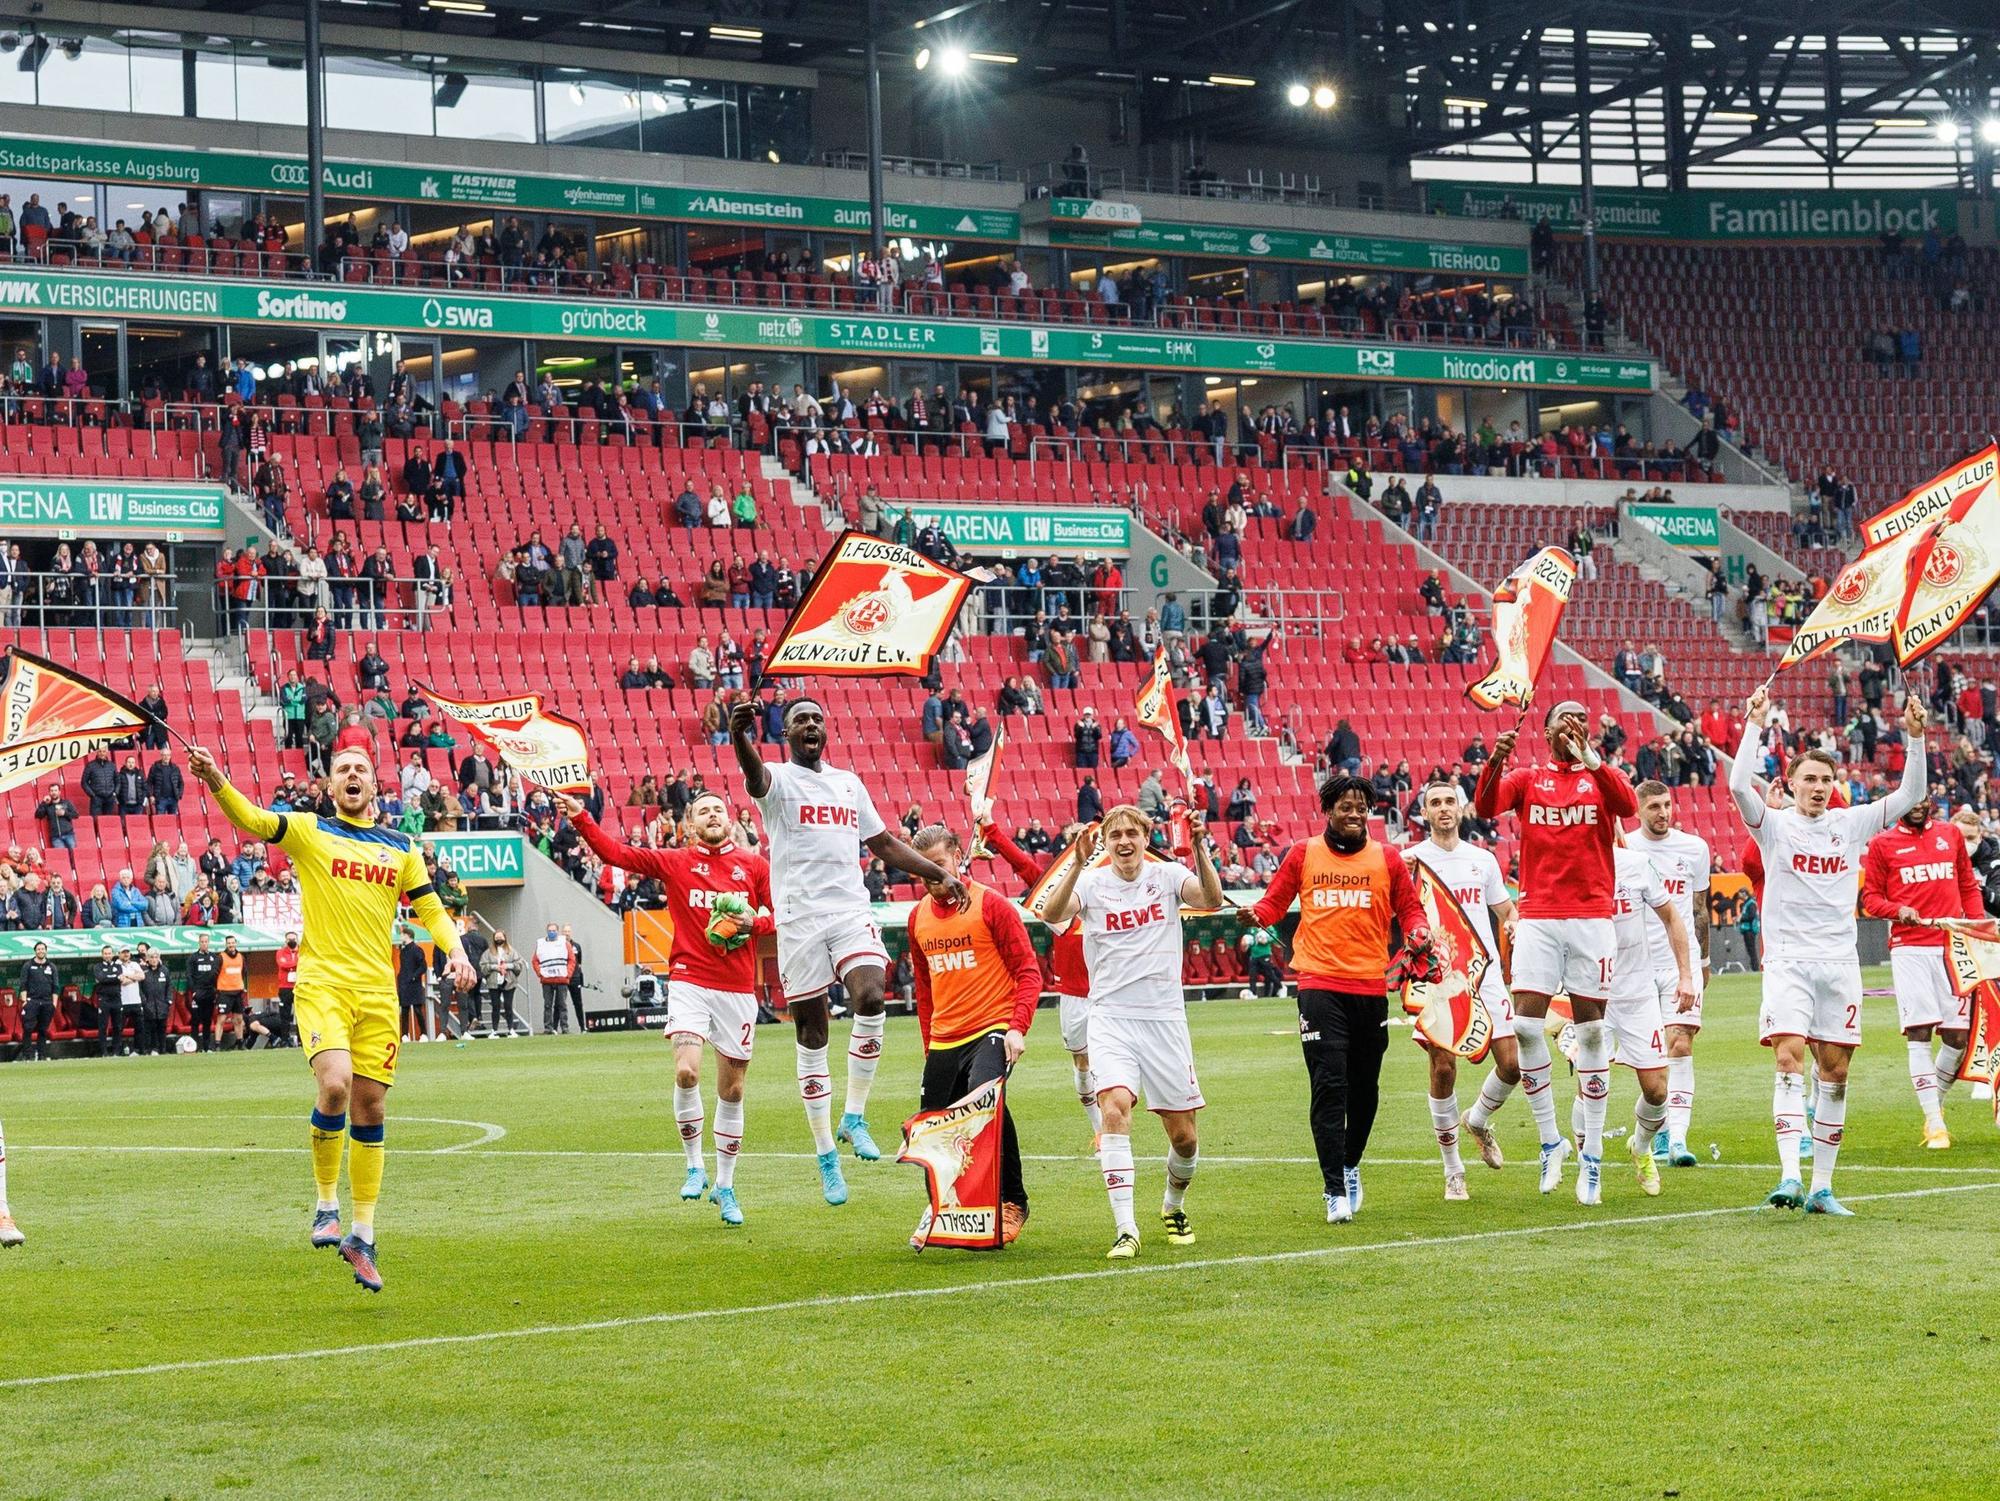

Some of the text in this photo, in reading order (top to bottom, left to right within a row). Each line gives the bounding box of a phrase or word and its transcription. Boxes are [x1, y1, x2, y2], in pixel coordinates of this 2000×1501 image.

[0, 151, 200, 183] Stadtsparkasse Augsburg
[323, 170, 374, 189] Audi
[451, 174, 517, 189] KASTNER
[705, 196, 803, 219] Abenstein
[834, 208, 908, 228] aumller
[1708, 199, 1939, 232] Familienblock
[1429, 252, 1501, 272] TIERHOLD
[47, 284, 217, 313] VERSICHERUNGEN
[257, 290, 347, 321] Sortimo
[445, 306, 494, 327] swa
[561, 308, 647, 333] grünbeck
[830, 323, 936, 343] STADLER
[1357, 349, 1395, 368] PCI
[1443, 356, 1511, 381] hitradio
[89, 492, 123, 520] LEW
[128, 499, 187, 516] Business
[189, 502, 219, 518] Club
[943, 515, 1013, 542] ARENA
[1023, 517, 1050, 542] LEW
[1053, 523, 1099, 538] Business
[1100, 524, 1124, 539] Club
[1666, 517, 1716, 537] ARENA
[1151, 554, 1169, 588] G
[1727, 553, 1745, 585] H
[799, 804, 859, 829] REWE
[1529, 805, 1598, 826] REWE
[438, 844, 519, 873] ARENA
[1791, 852, 1849, 875] REWE
[331, 858, 398, 888] REWE
[1312, 872, 1371, 887] uhlsport
[1899, 861, 1955, 885] REWE
[1312, 889, 1373, 909] REWE
[1105, 902, 1166, 932] REWE
[922, 934, 973, 952] uhlsport
[383, 1042, 398, 1070] 2
